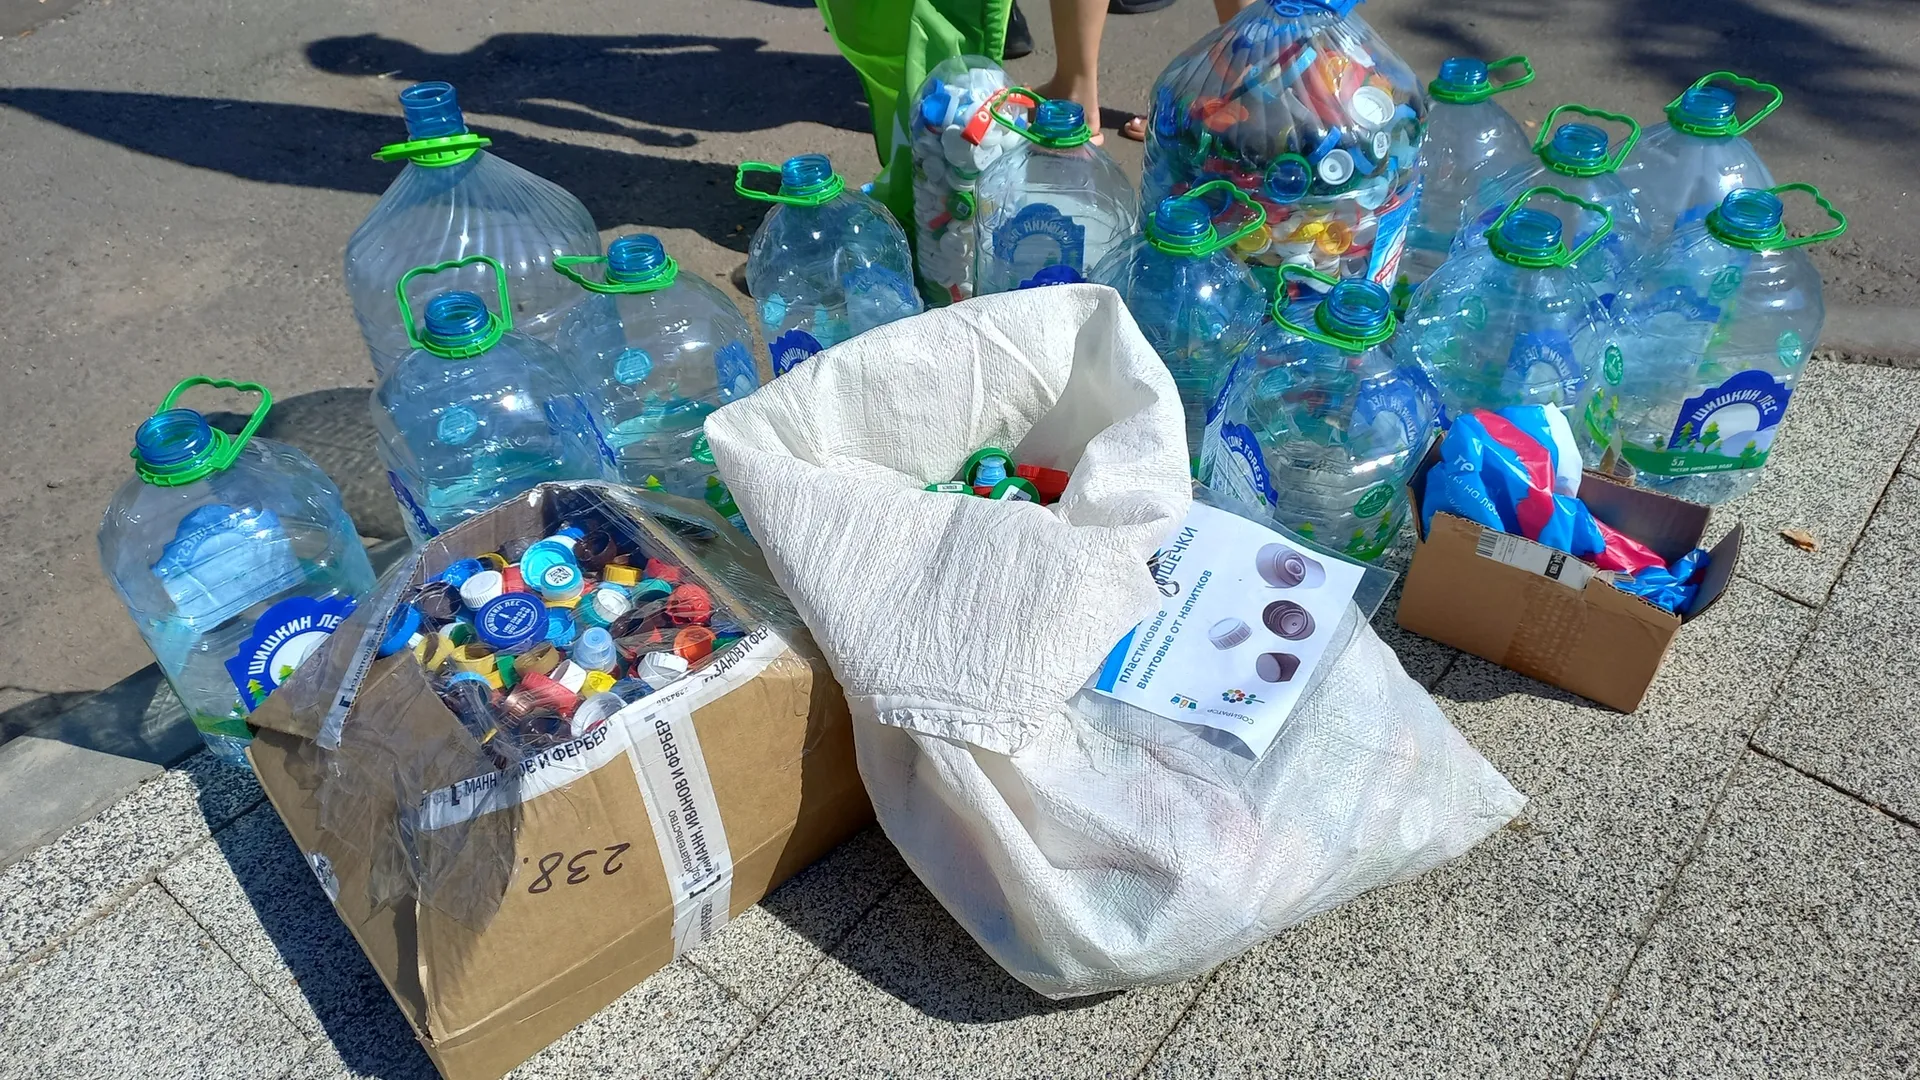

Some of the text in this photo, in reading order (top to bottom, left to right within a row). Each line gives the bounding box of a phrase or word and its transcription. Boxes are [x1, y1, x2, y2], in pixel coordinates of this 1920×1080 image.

[1692, 388, 1778, 422] ШИШКИН ЛЕС
[1243, 443, 1265, 492] FOREST
[1154, 526, 1199, 583] ШЕЧКИ
[248, 613, 344, 675] ШИШКИН ЛЕ
[552, 725, 608, 764] ФЕРБЕР
[655, 719, 681, 768] ФЕРБЕР
[671, 768, 684, 780] И
[675, 777, 698, 830] ИВАНОВ
